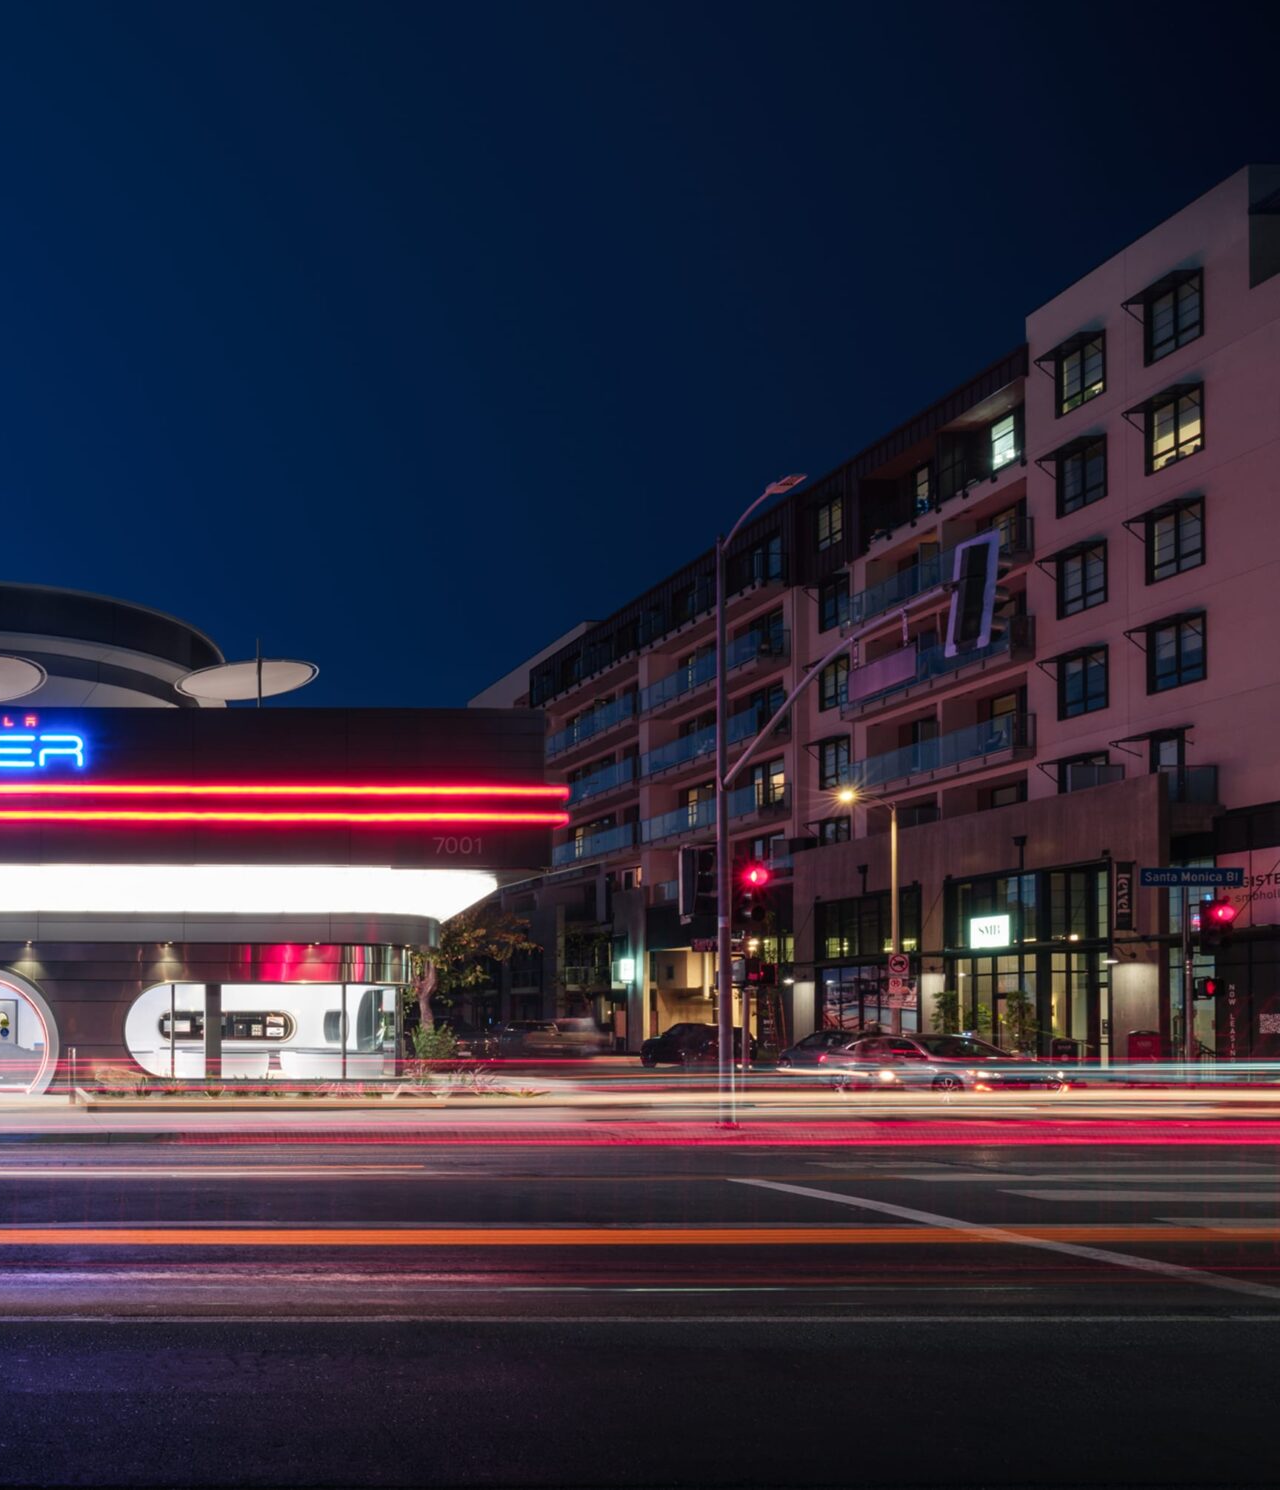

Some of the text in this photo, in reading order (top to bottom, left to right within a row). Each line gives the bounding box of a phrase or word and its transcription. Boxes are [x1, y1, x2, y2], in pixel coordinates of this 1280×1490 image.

[431, 836, 483, 855] 7001
[1145, 871, 1178, 883] Santa
[1180, 870, 1223, 882] Monica
[1117, 873, 1131, 913] level
[1228, 984, 1237, 1006] NOW
